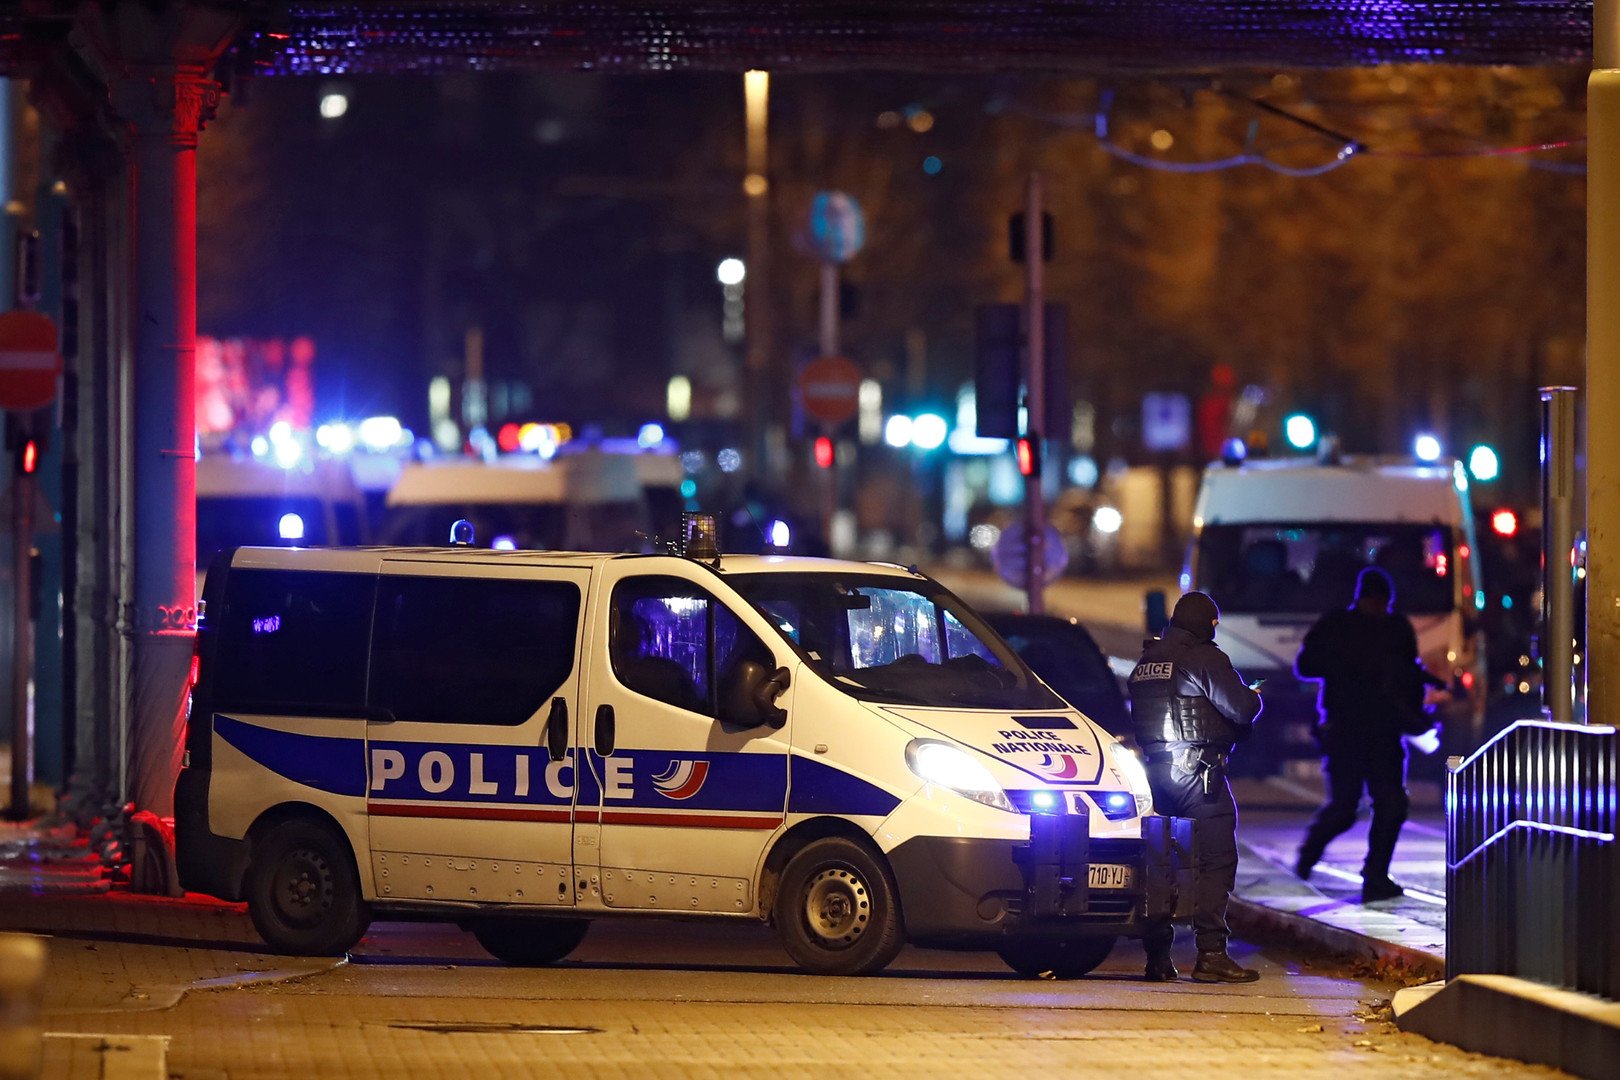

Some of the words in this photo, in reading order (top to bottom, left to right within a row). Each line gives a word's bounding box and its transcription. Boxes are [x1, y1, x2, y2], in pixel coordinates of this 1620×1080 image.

[1136, 663, 1171, 676] OLICE
[997, 730, 1062, 741] POLICE
[992, 742, 1091, 756] NATIONALE
[371, 749, 635, 799] POLICE
